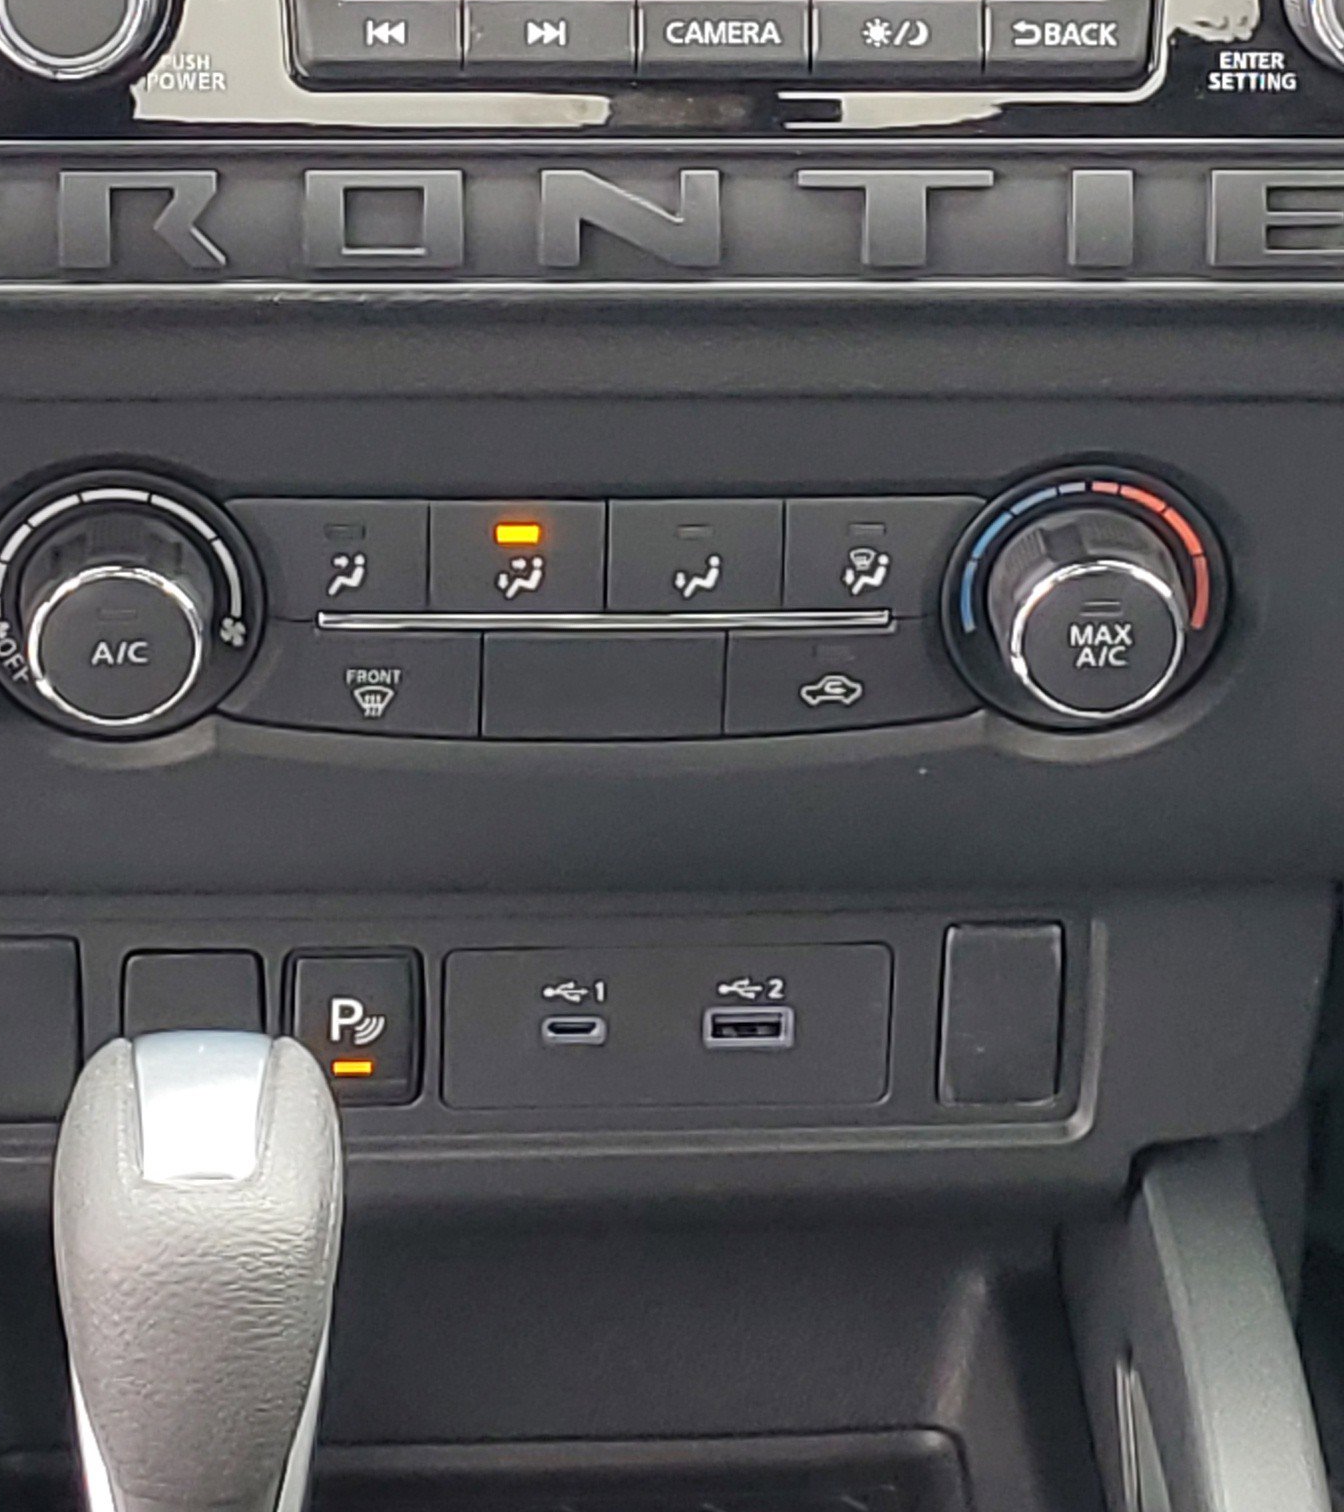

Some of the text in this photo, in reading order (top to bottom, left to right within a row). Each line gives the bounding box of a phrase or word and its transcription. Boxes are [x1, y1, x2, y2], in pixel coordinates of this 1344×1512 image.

[665, 20, 782, 46] CAMERA
[1043, 20, 1119, 47] BACK
[1219, 51, 1285, 71] ENTER
[146, 71, 227, 92] POWER
[1207, 72, 1298, 92] SETTING
[1069, 623, 1134, 647] MAX
[90, 640, 150, 667] A/C
[1075, 645, 1129, 668] A/C
[346, 669, 402, 685] FRONT
[595, 981, 606, 1002] 1
[767, 979, 786, 1000] 2
[330, 998, 365, 1043] P
